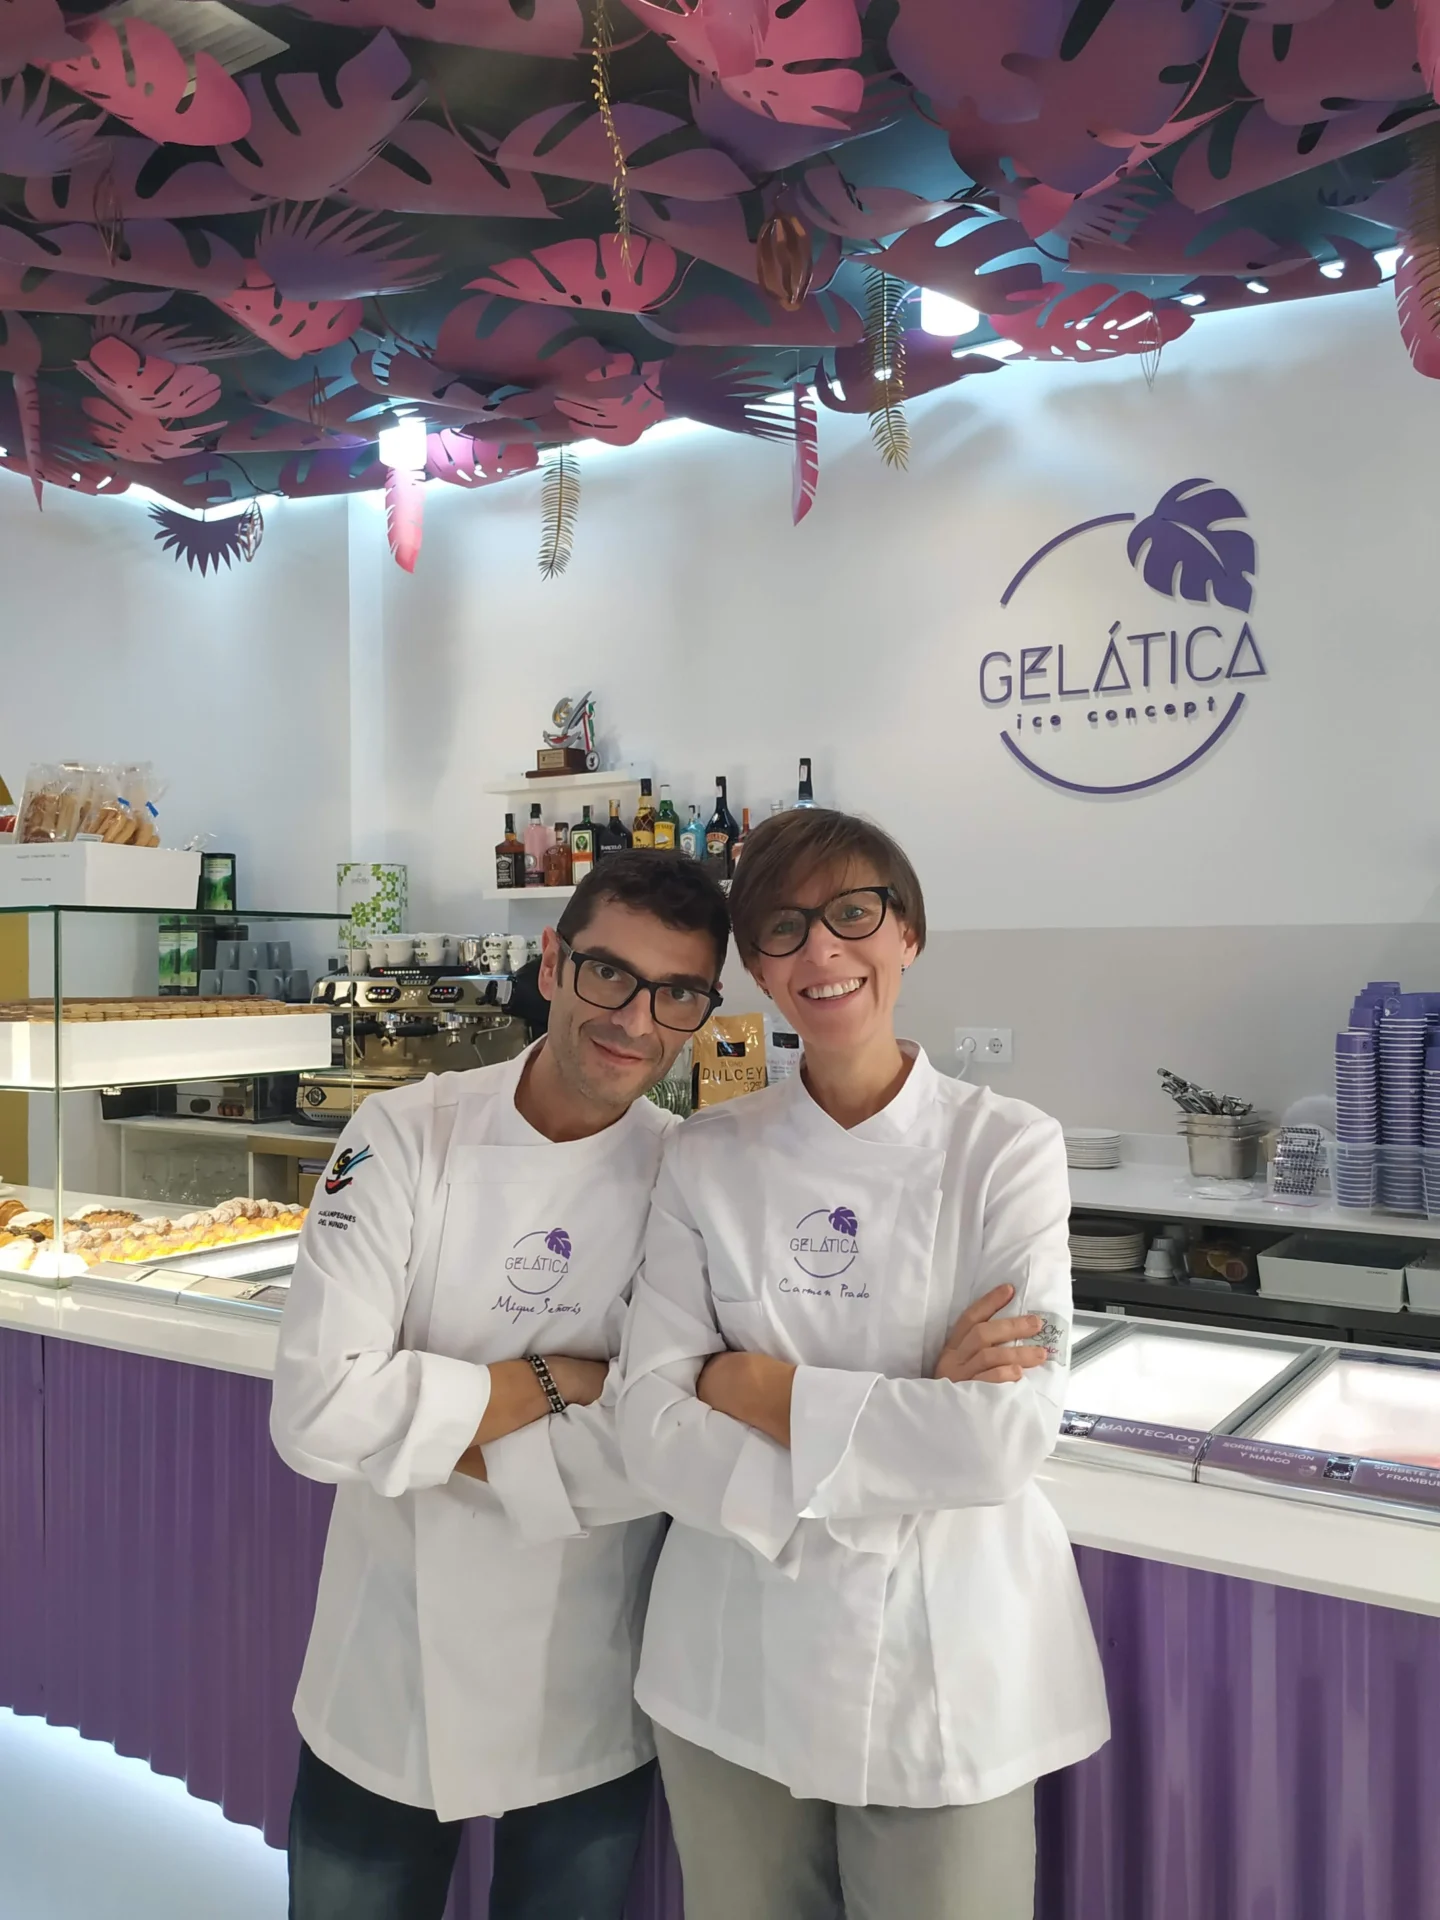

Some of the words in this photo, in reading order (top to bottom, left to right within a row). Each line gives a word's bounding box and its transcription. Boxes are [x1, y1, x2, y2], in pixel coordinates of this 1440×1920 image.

[979, 620, 1267, 704] GELÁTICA
[1016, 713, 1062, 730] ice
[1086, 696, 1216, 722] concept
[702, 1066, 763, 1082] DULCEY
[328, 1220, 348, 1230] MUNDO
[789, 1236, 859, 1254] GELÁTICA
[504, 1254, 569, 1274] GELÁTICA
[778, 1277, 832, 1297] Carmen
[840, 1282, 870, 1299] Prado
[1098, 1422, 1201, 1445] MANTECADO
[1222, 1441, 1271, 1454] SORBETE
[1249, 1453, 1291, 1465] MANGO
[1373, 1464, 1426, 1477] SORBETE
